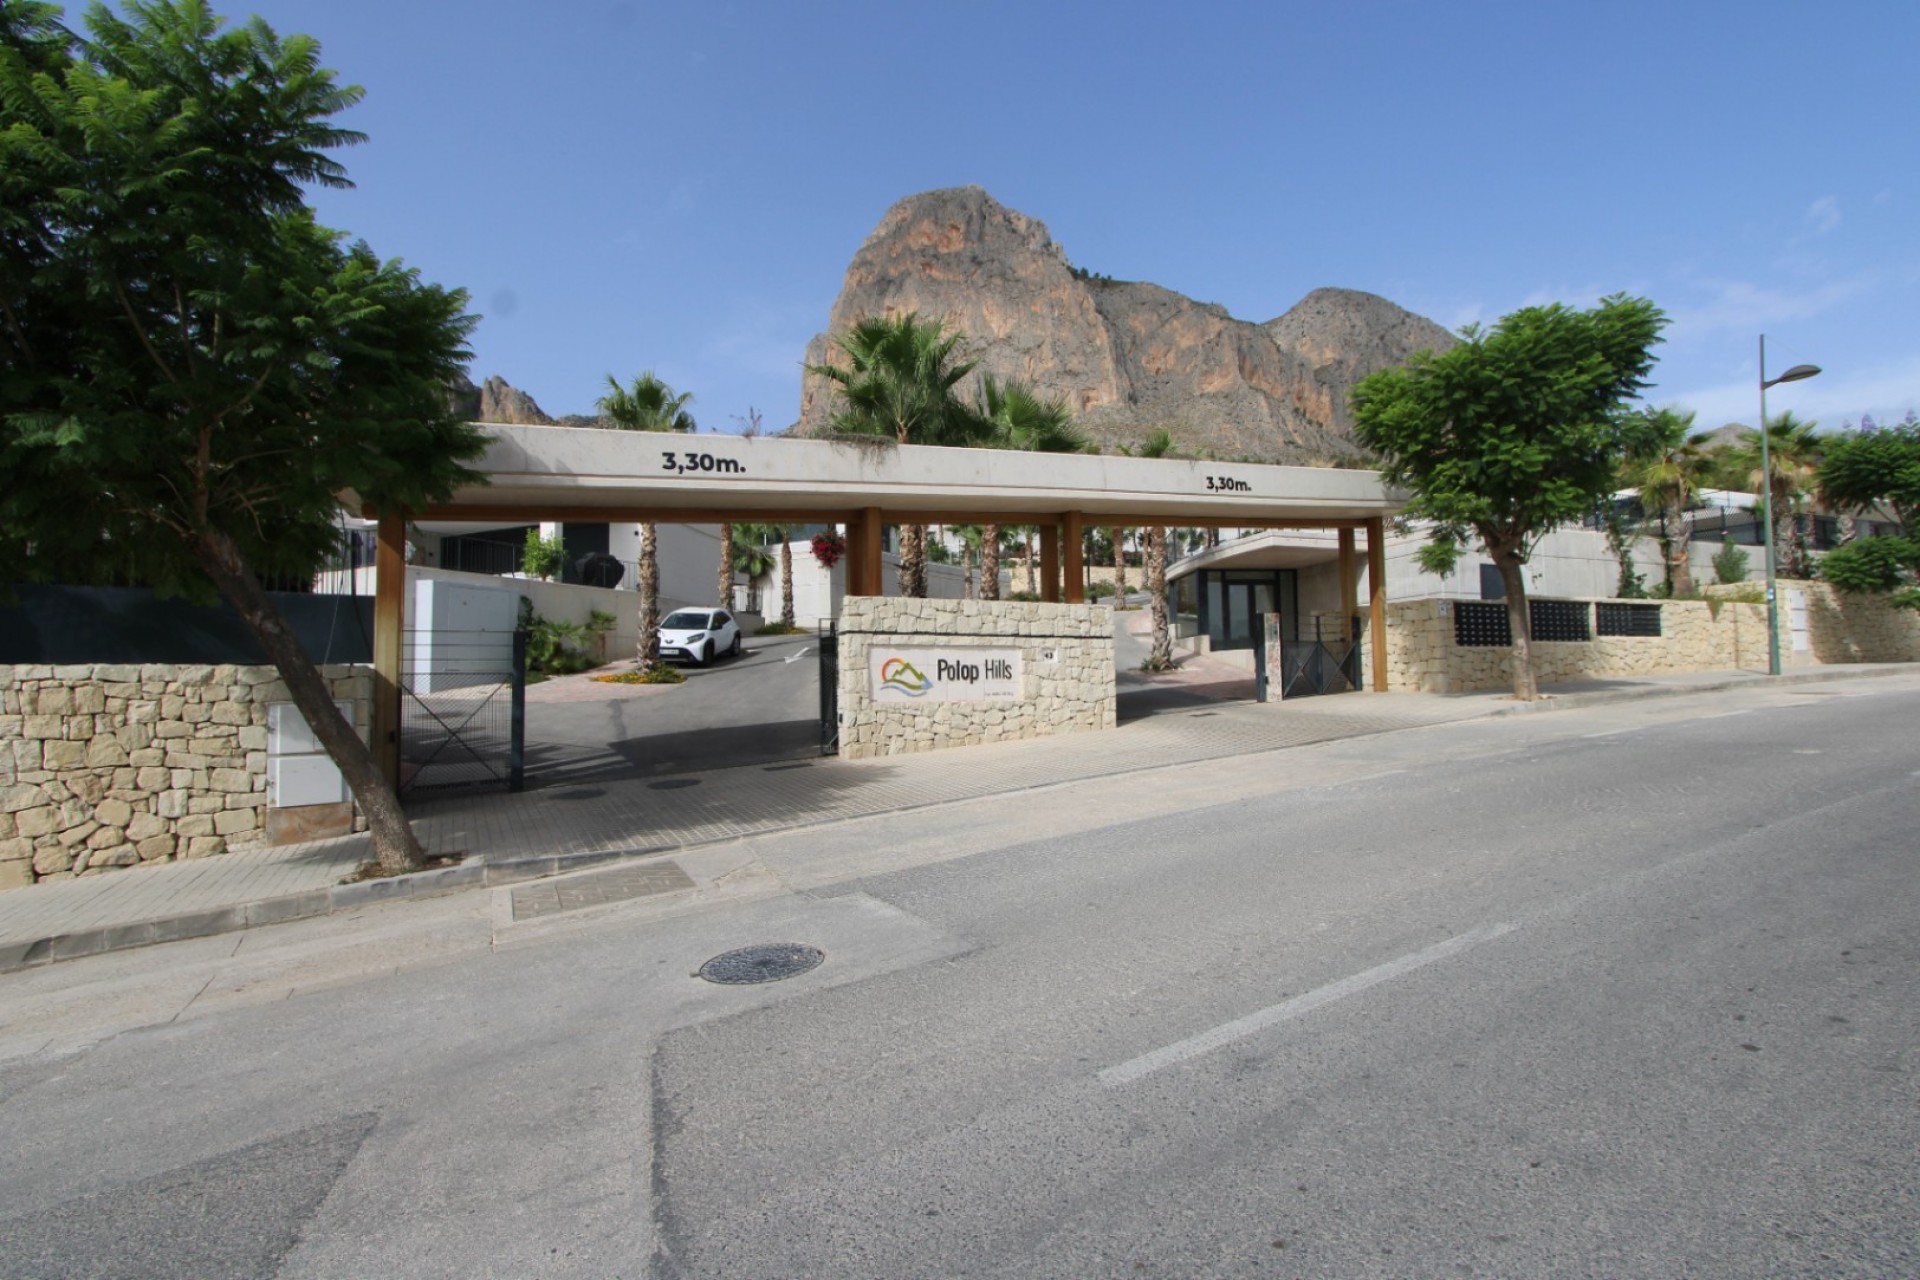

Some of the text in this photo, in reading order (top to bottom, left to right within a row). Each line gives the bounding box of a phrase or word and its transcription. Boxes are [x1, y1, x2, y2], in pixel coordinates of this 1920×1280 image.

[661, 452, 746, 474] 3,30m.
[1206, 476, 1252, 493] 3,30m.
[937, 658, 1012, 684] Polop Hills
